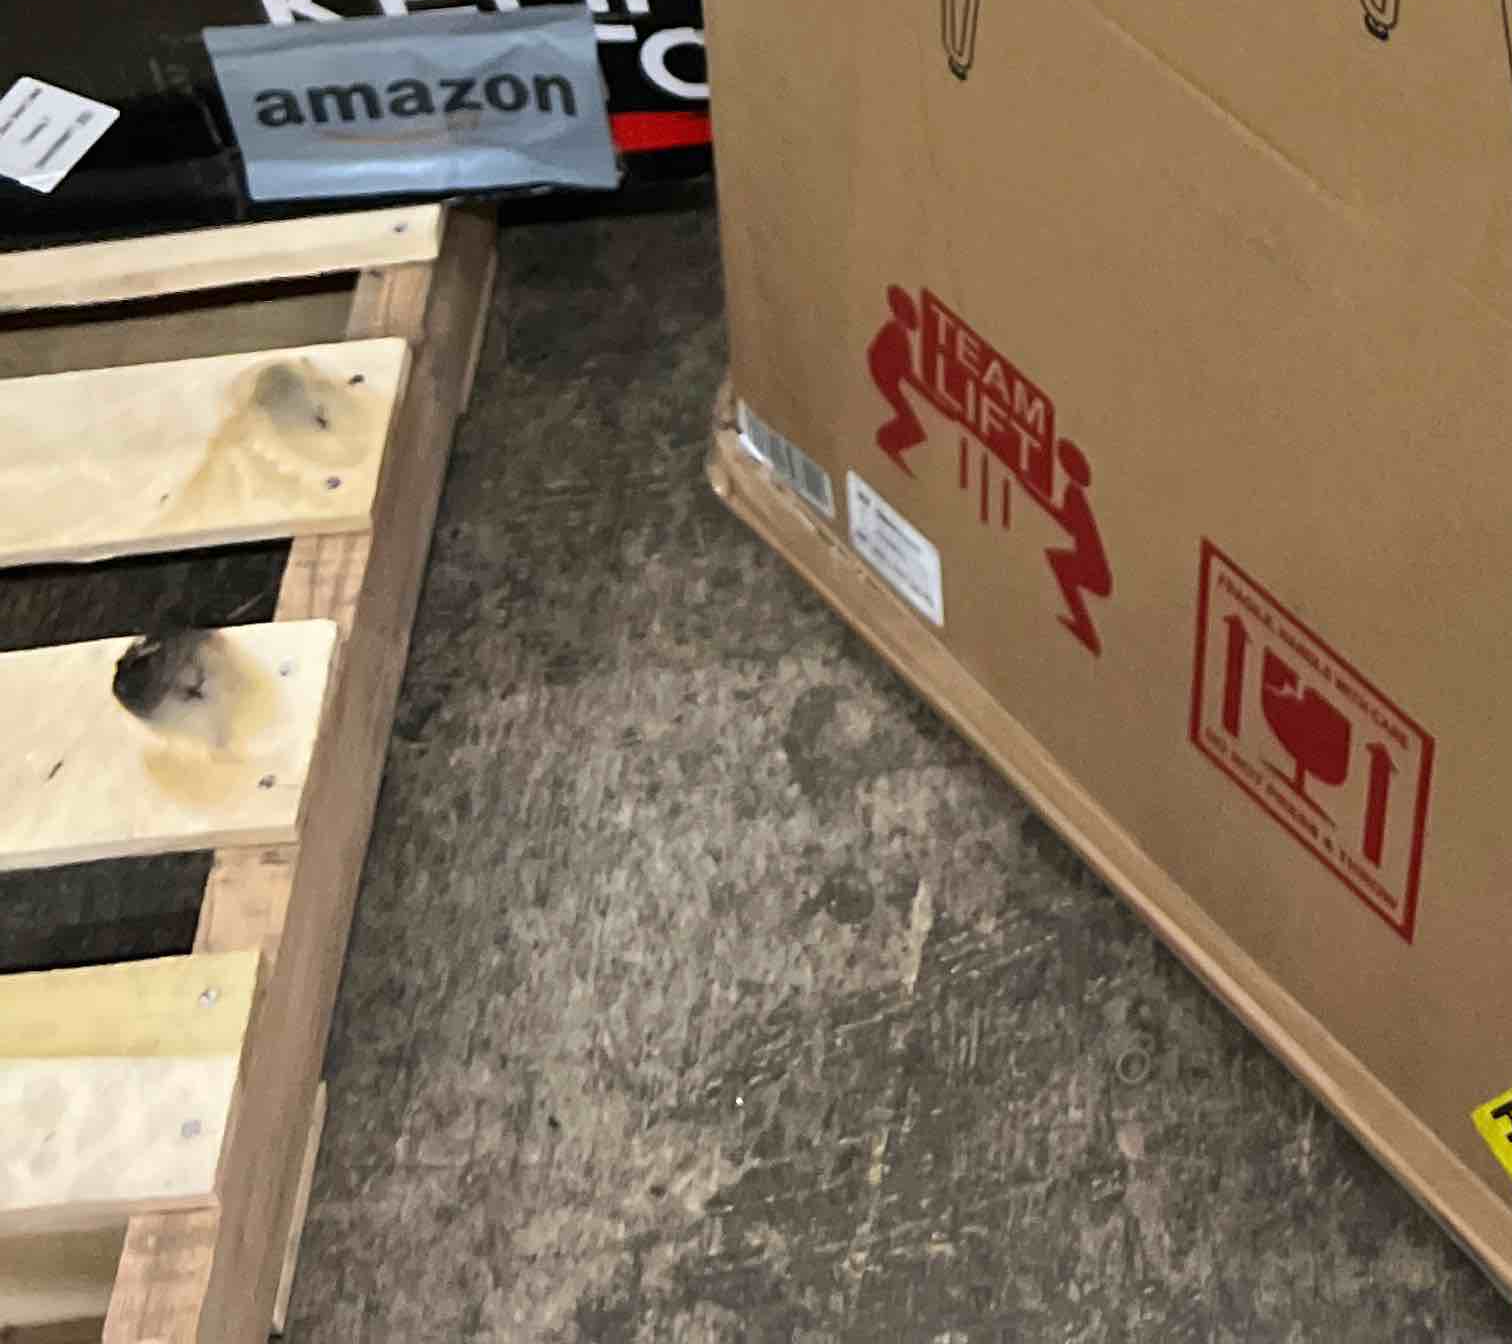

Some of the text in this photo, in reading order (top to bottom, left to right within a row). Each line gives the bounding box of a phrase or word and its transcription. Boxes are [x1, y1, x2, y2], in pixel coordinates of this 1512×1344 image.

[253, 68, 579, 129] amazon
[930, 303, 1046, 435] TEAM
[937, 354, 1043, 472] LIFT
